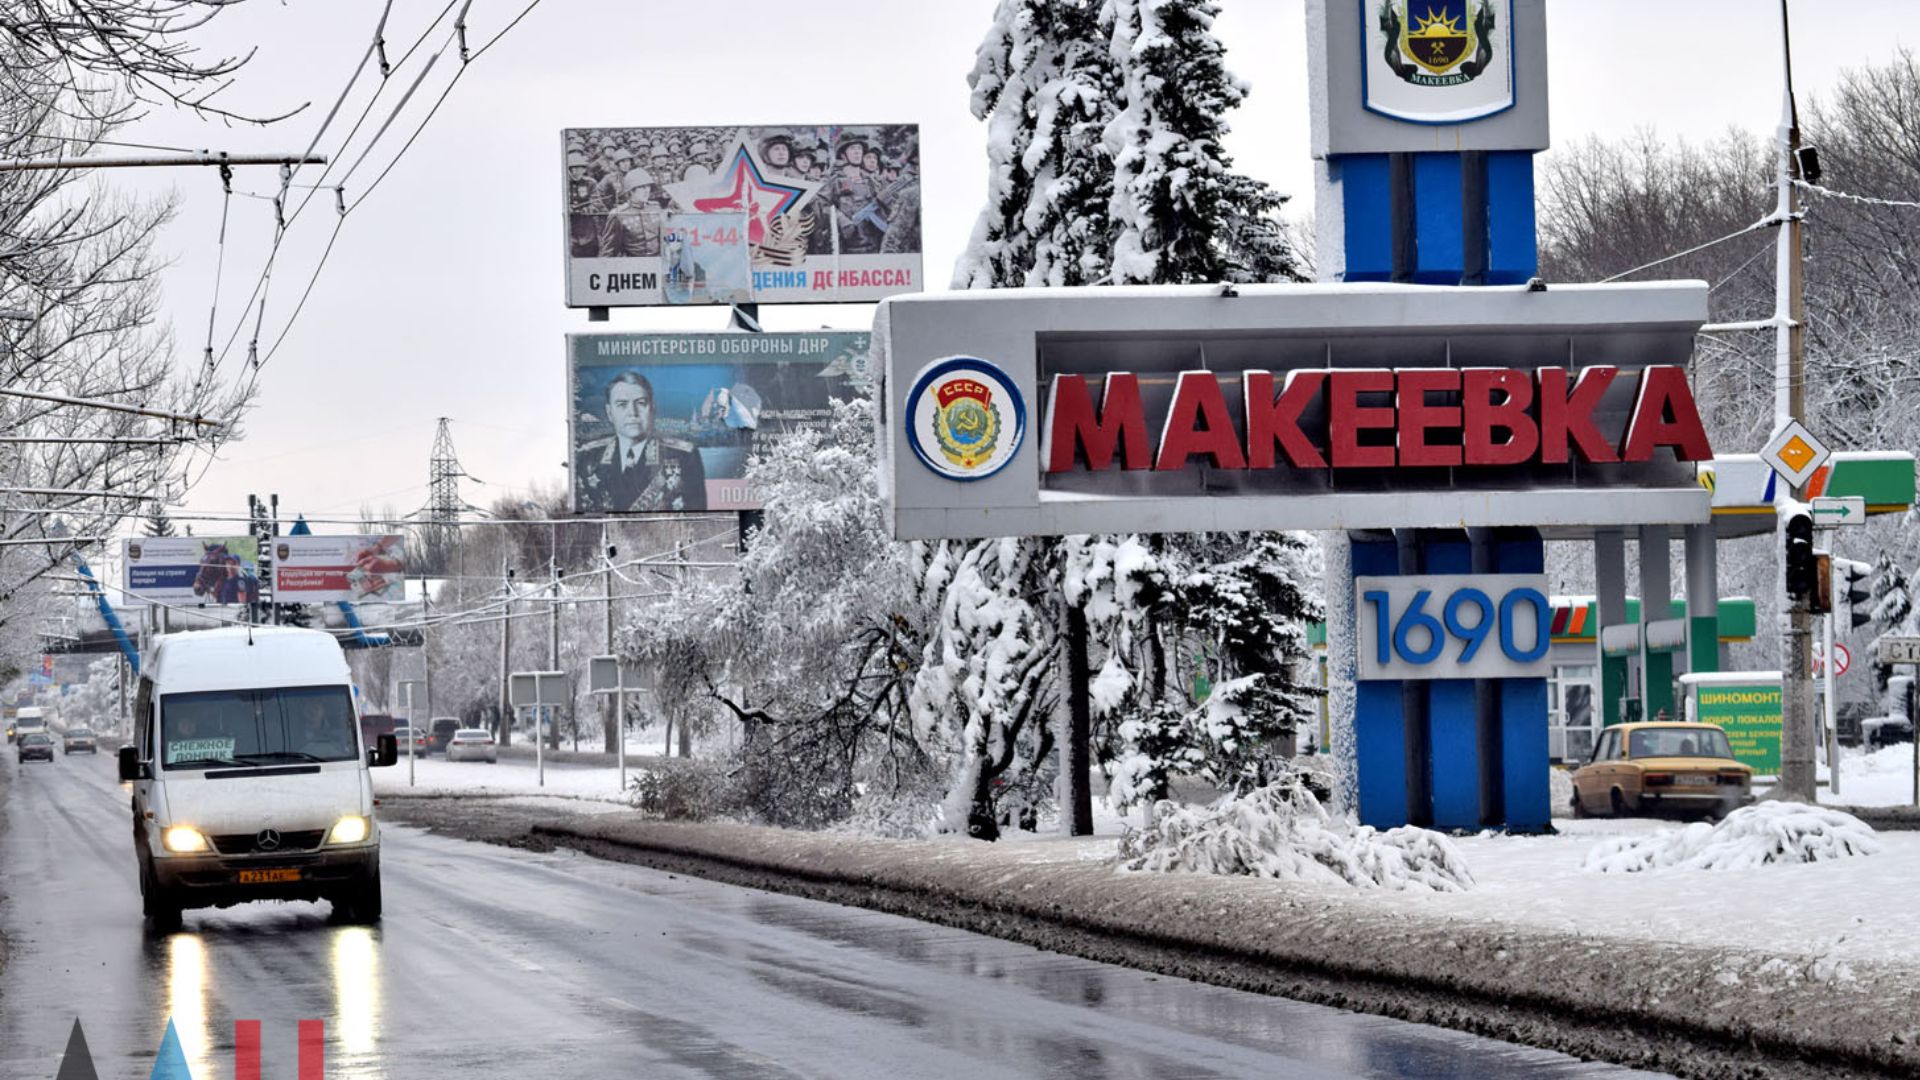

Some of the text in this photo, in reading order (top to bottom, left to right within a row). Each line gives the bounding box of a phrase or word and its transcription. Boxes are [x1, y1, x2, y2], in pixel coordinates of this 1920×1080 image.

[1428, 56, 1450, 64] 1690
[1410, 73, 1471, 86] МАКЕЕВКА
[589, 274, 600, 291] С
[607, 273, 657, 293] ДНЕМ
[752, 271, 807, 292] ДЕНИЯ
[598, 338, 829, 356] МИНИСТЕРСТВО ОБОРОНЫ ДНР
[944, 382, 984, 397] СССР
[1045, 366, 1713, 474] МАКЕЕВКА
[721, 487, 754, 502] ПОЛ
[1363, 587, 1550, 665] 1690
[1889, 641, 1920, 660] СТ
[1700, 691, 1783, 705] ШИНОМОНТ
[171, 740, 233, 751] СНЕЖНОЕ
[175, 751, 228, 762] ДОНЕЦК
